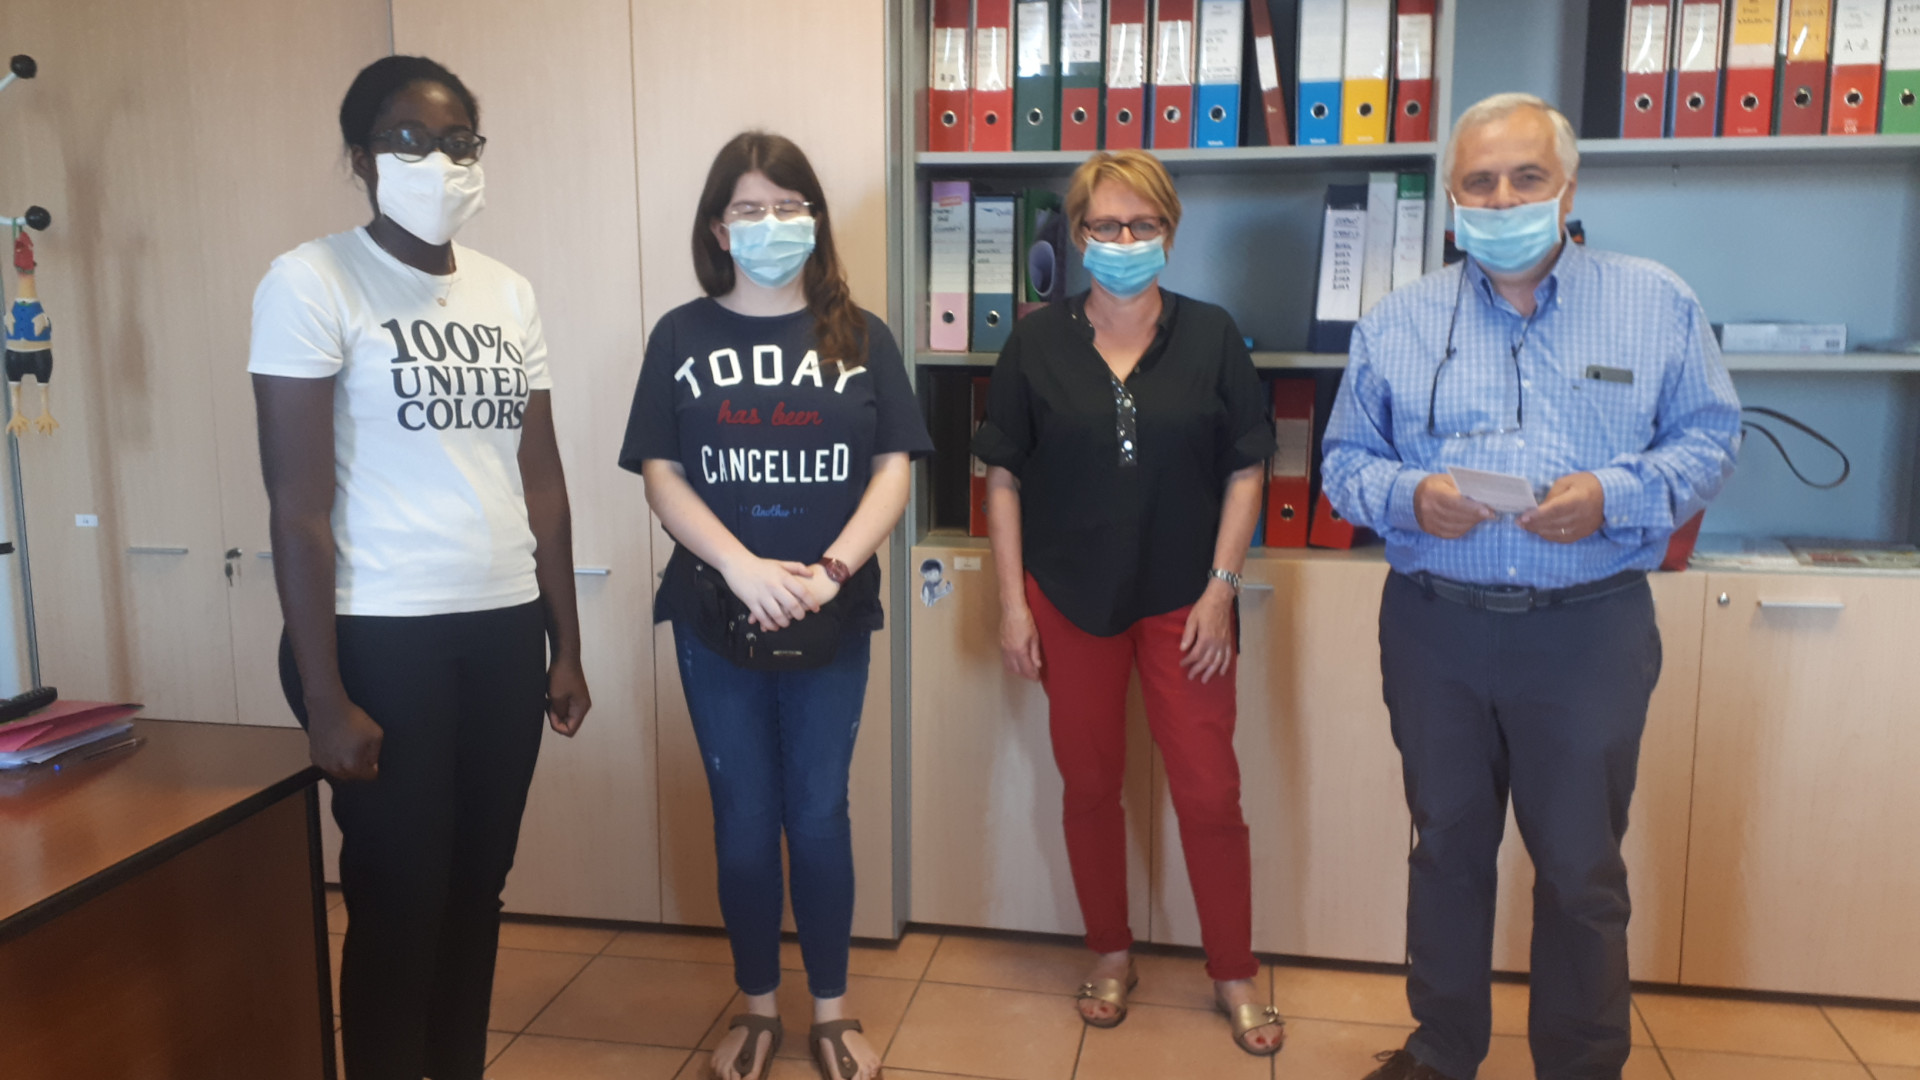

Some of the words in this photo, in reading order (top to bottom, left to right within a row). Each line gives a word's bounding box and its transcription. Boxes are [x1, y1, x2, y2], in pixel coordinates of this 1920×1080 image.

[381, 318, 523, 365] 100%
[391, 365, 528, 399] UNITED
[674, 344, 867, 399] TODAY
[397, 398, 525, 431] COLORS
[716, 399, 762, 426] has
[771, 401, 823, 426] been
[701, 443, 849, 485] CANCELLED
